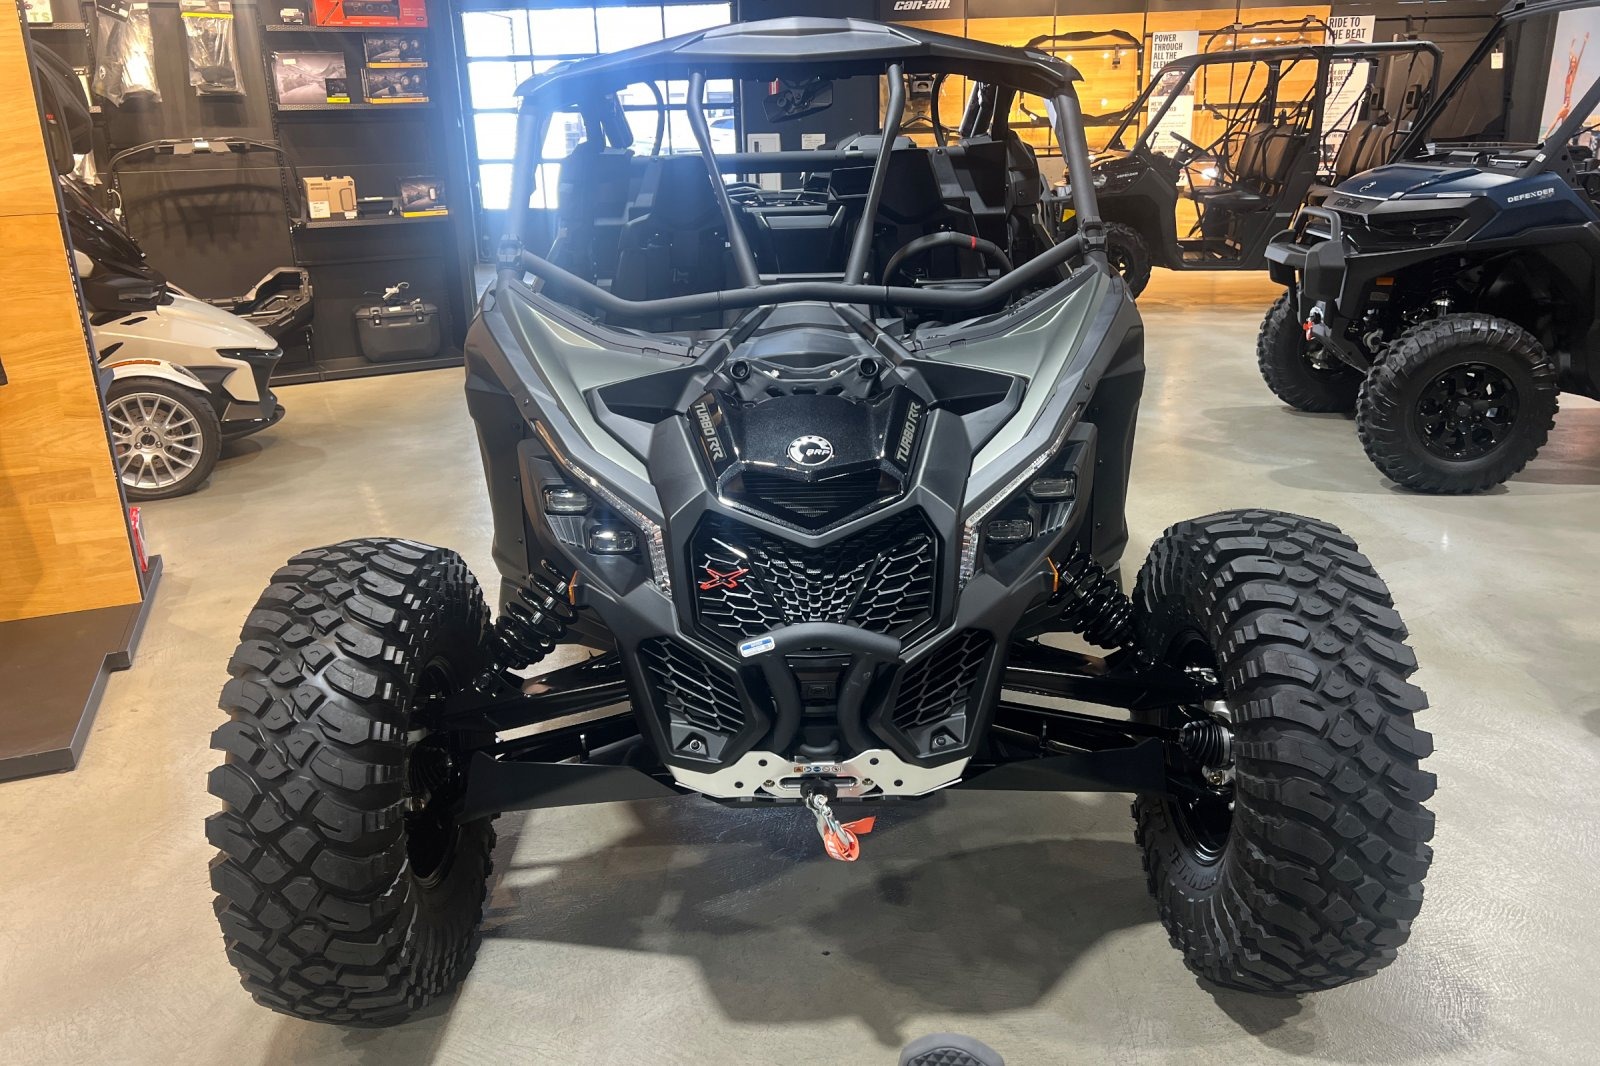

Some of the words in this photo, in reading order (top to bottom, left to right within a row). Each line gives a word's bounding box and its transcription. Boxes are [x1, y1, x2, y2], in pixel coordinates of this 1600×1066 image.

[1329, 17, 1348, 28] RIDE
[1350, 17, 1361, 28] TO
[1154, 34, 1177, 42] POWER
[1345, 28, 1367, 39] BEAT
[1154, 43, 1183, 51] THROUGH
[1153, 52, 1164, 60] ALL
[1165, 51, 1177, 60] THE
[1507, 187, 1555, 203] DEFENDER
[694, 402, 716, 436] TURBO
[706, 436, 724, 461] RR
[896, 421, 916, 462] TURBO
[907, 401, 921, 424] RR
[806, 448, 831, 456] BRP
